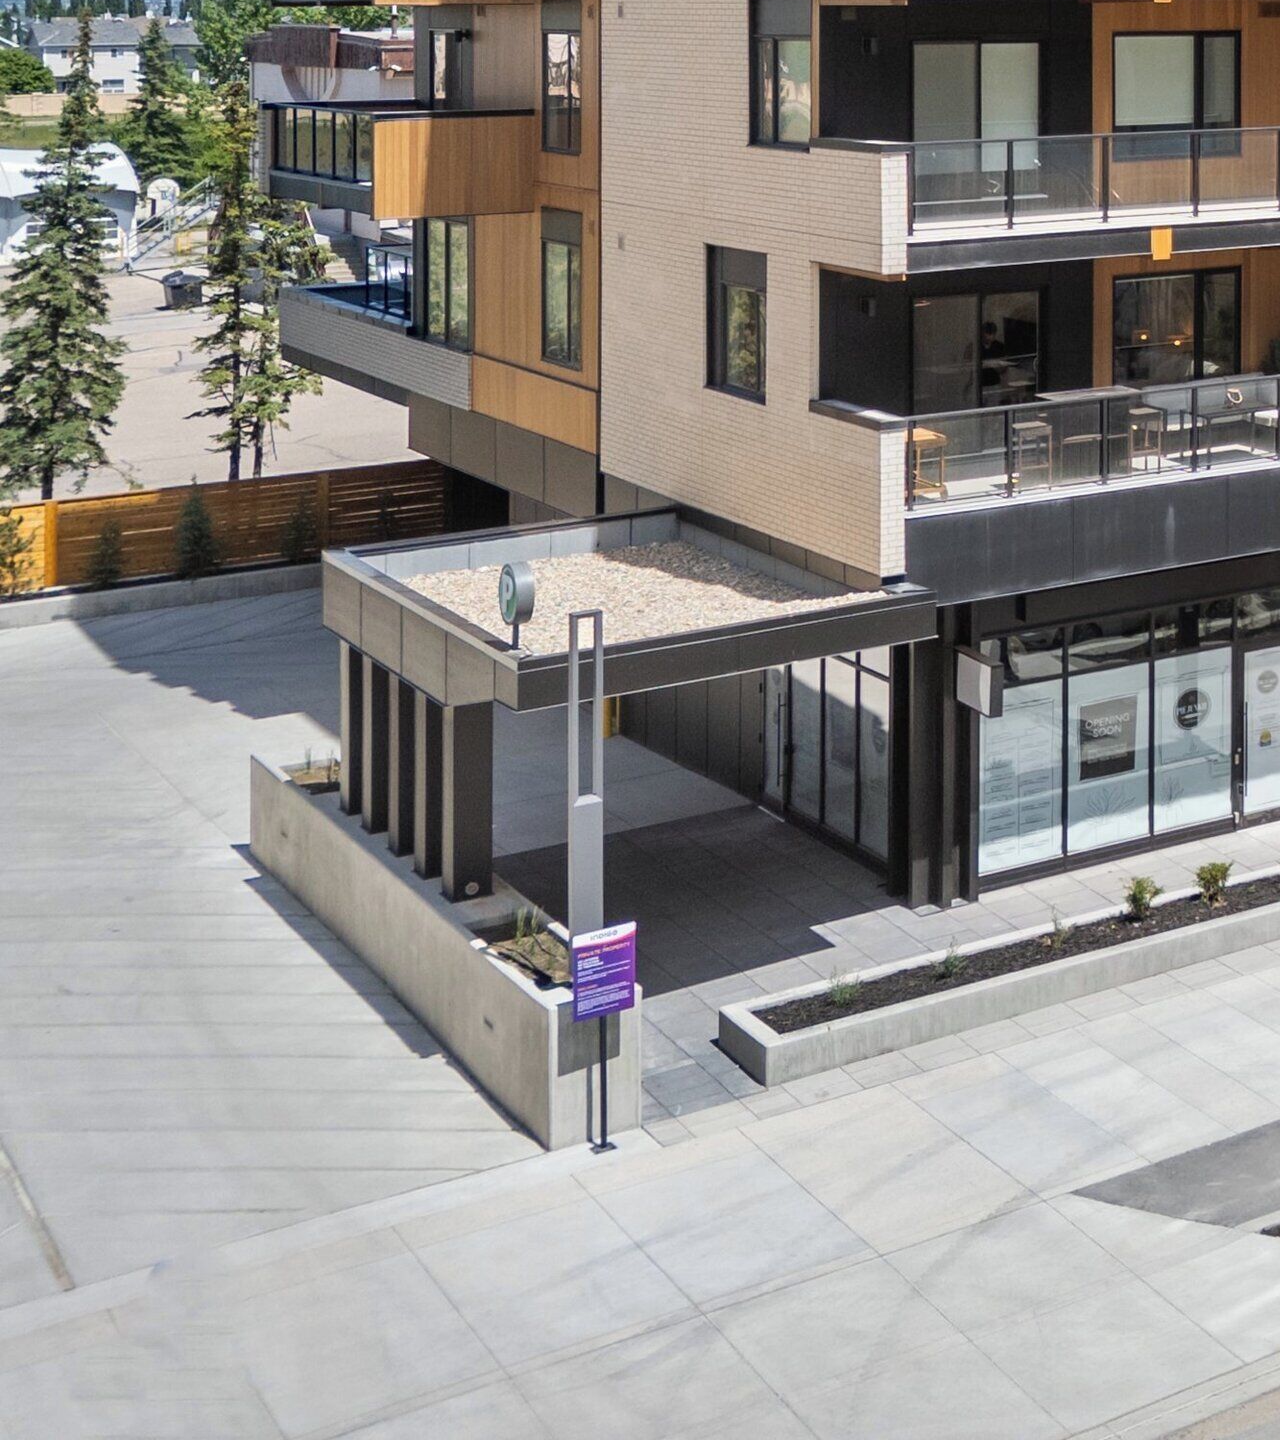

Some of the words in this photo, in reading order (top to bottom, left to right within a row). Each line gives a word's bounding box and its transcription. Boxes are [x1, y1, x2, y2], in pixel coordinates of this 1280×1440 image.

[502, 574, 513, 613] P
[1085, 712, 1130, 729] OPENING
[1093, 725, 1121, 737] SOON
